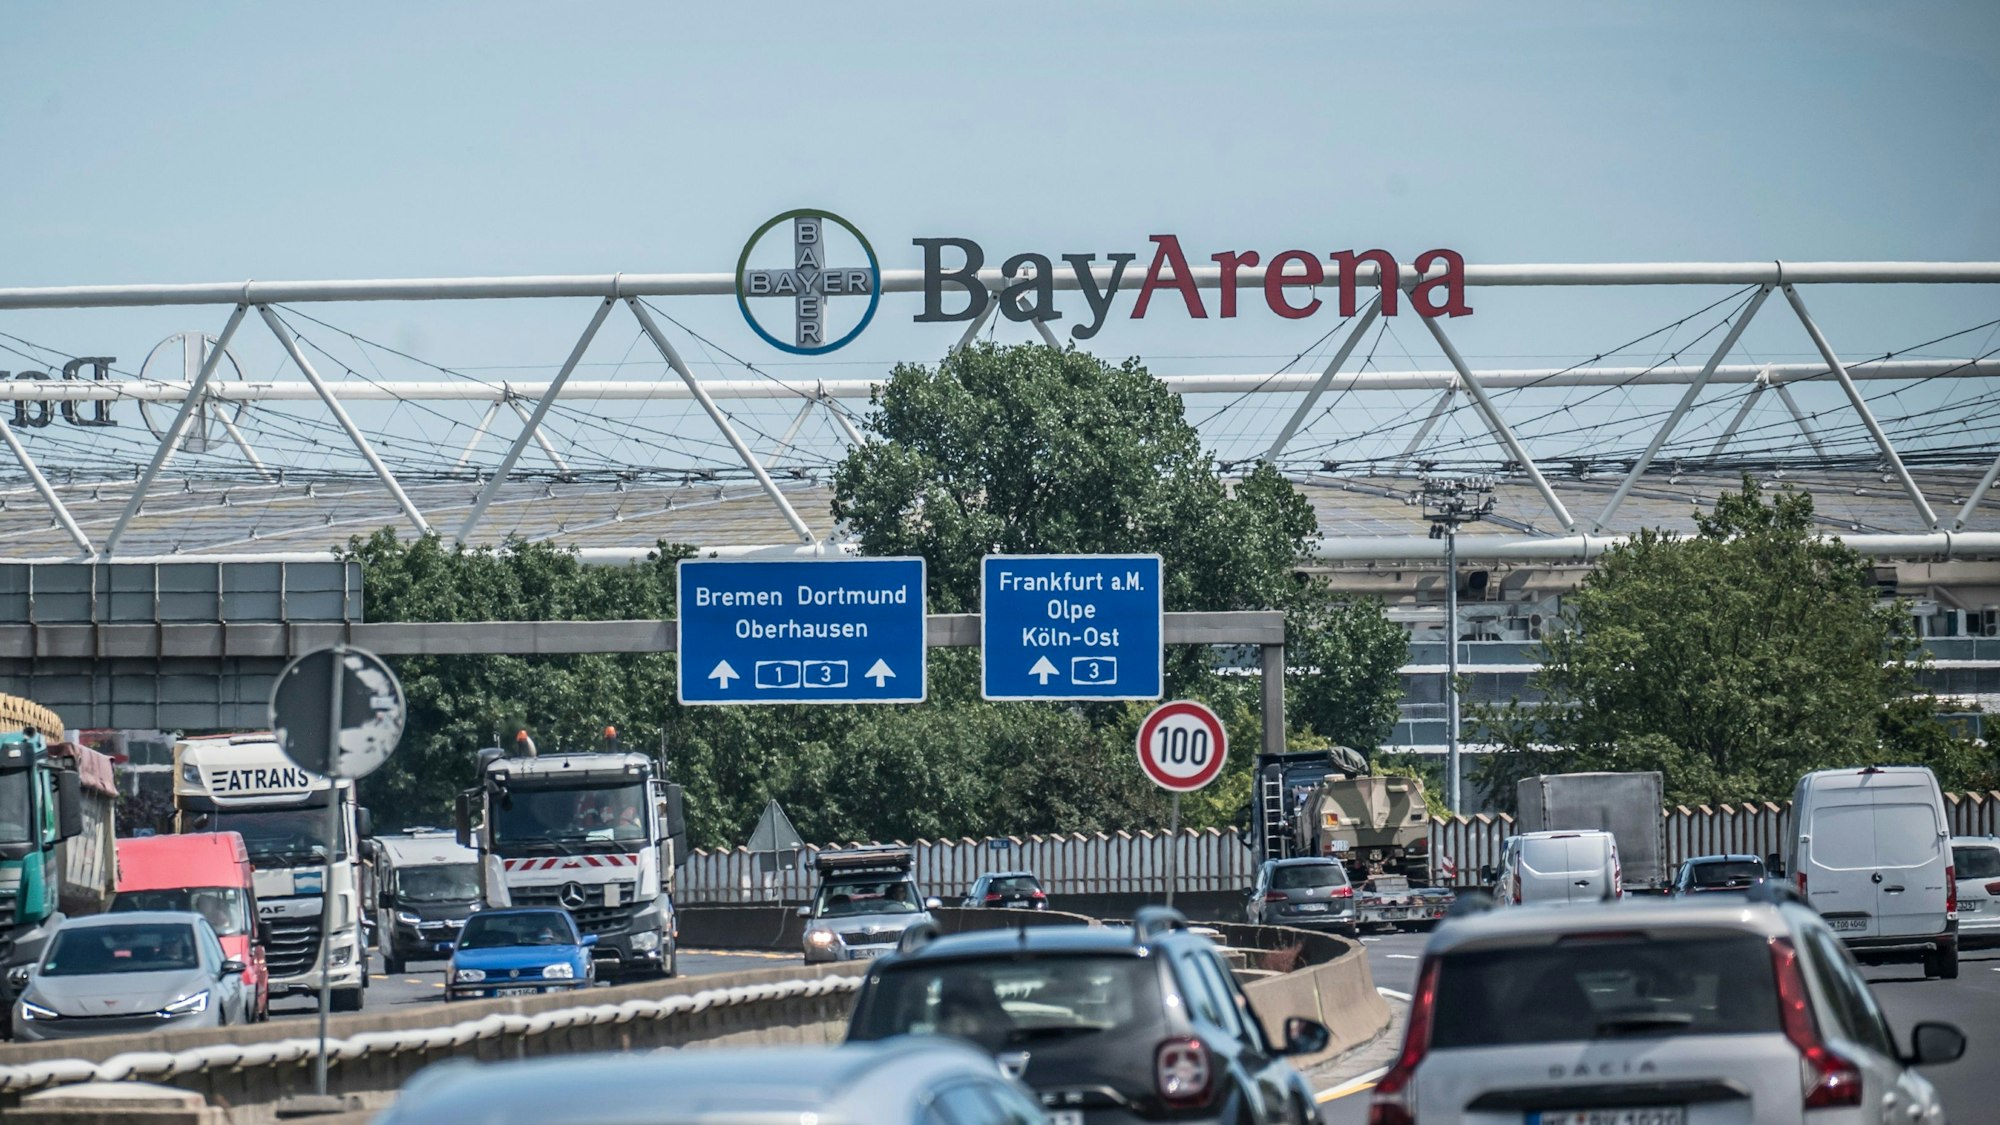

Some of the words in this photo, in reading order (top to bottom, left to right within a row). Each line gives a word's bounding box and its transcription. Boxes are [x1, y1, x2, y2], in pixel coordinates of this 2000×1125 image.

[750, 271, 867, 294] BAYER
[797, 223, 821, 342] BAYER
[912, 234, 1473, 340] BayArena
[1000, 572, 1103, 591] Frankfurt
[1111, 572, 1145, 591] a.M.
[696, 587, 782, 606] Bremen
[798, 585, 907, 605] Dortmund
[1047, 600, 1097, 623] Olpe
[735, 619, 868, 638] Oberhausen
[1022, 627, 1120, 647] Köln-Ost
[775, 666, 783, 683] 1
[820, 665, 832, 682] 3
[1089, 662, 1100, 679] 3
[1158, 726, 1208, 766] 100
[1549, 1061, 1657, 1079] DACIA
